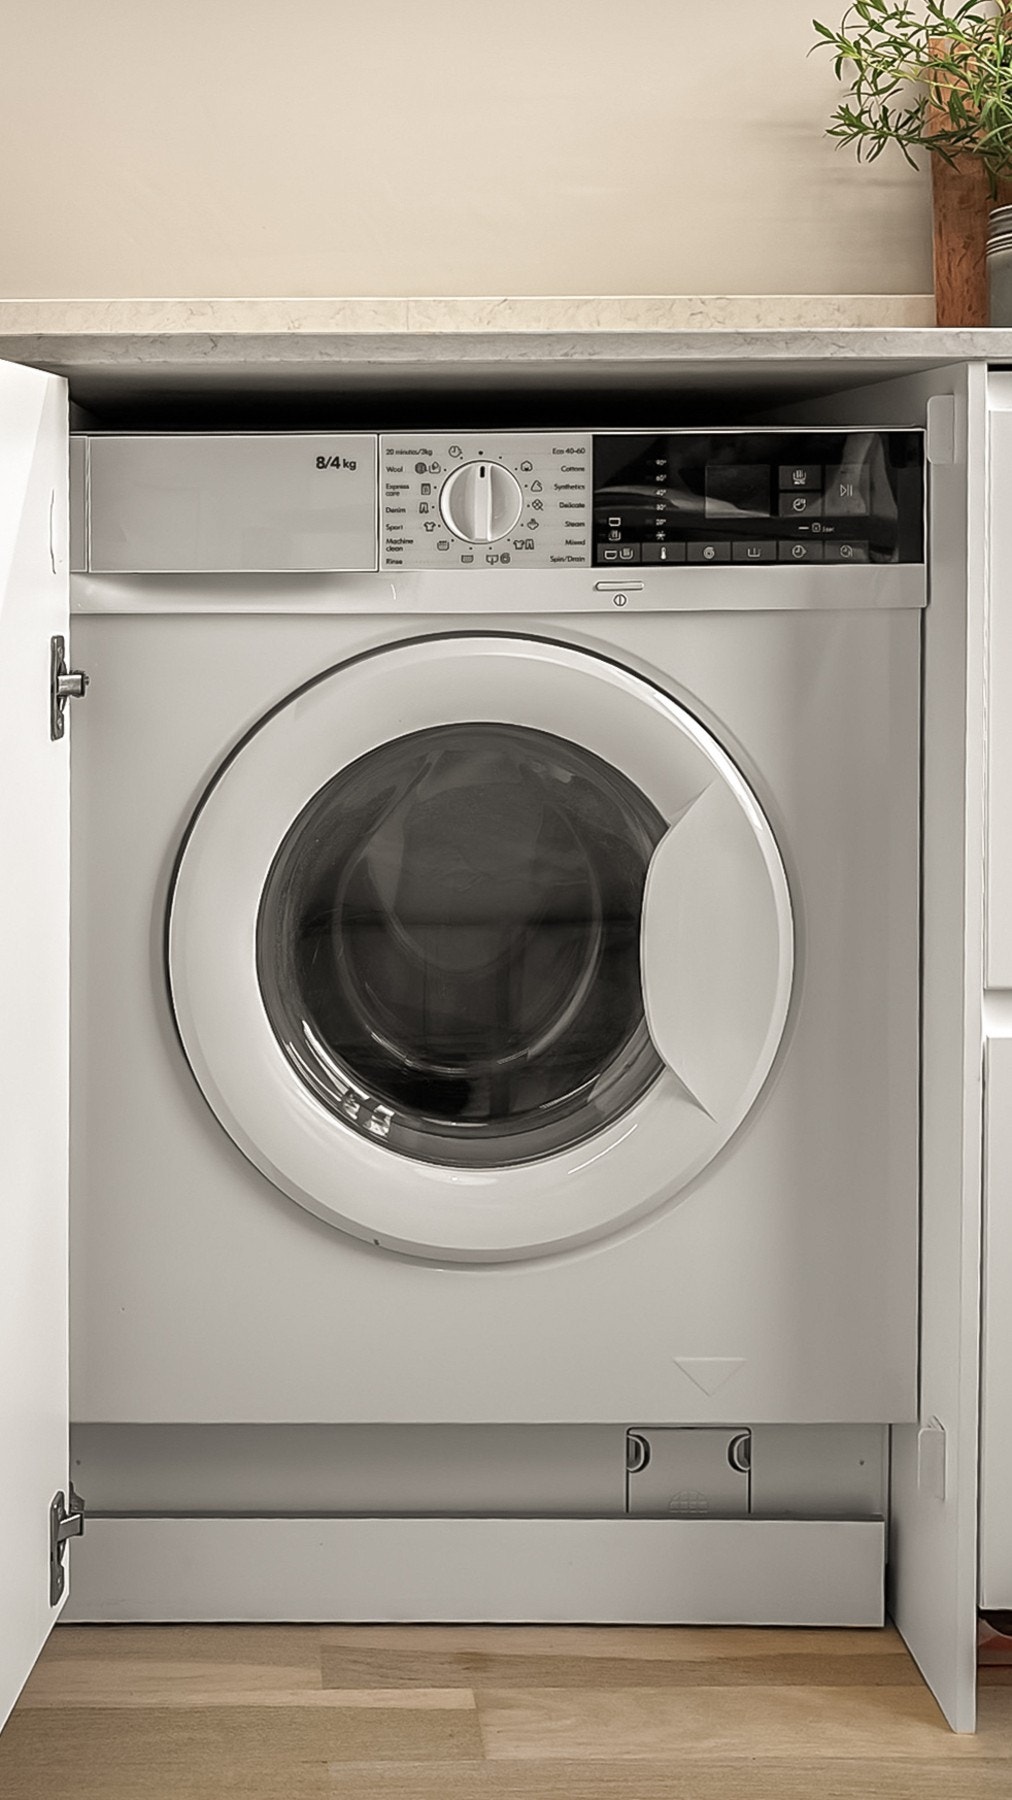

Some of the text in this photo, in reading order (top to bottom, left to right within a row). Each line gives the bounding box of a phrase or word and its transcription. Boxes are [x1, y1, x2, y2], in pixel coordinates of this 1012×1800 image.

[385, 448, 394, 456] 20
[552, 447, 564, 455] Eco
[316, 455, 357, 471] 8/4 kg
[554, 483, 586, 491] Synthetics
[385, 506, 406, 514] Denim
[385, 523, 404, 532] Sport
[564, 520, 586, 528] Steam
[549, 555, 586, 563] Spin/Drain
